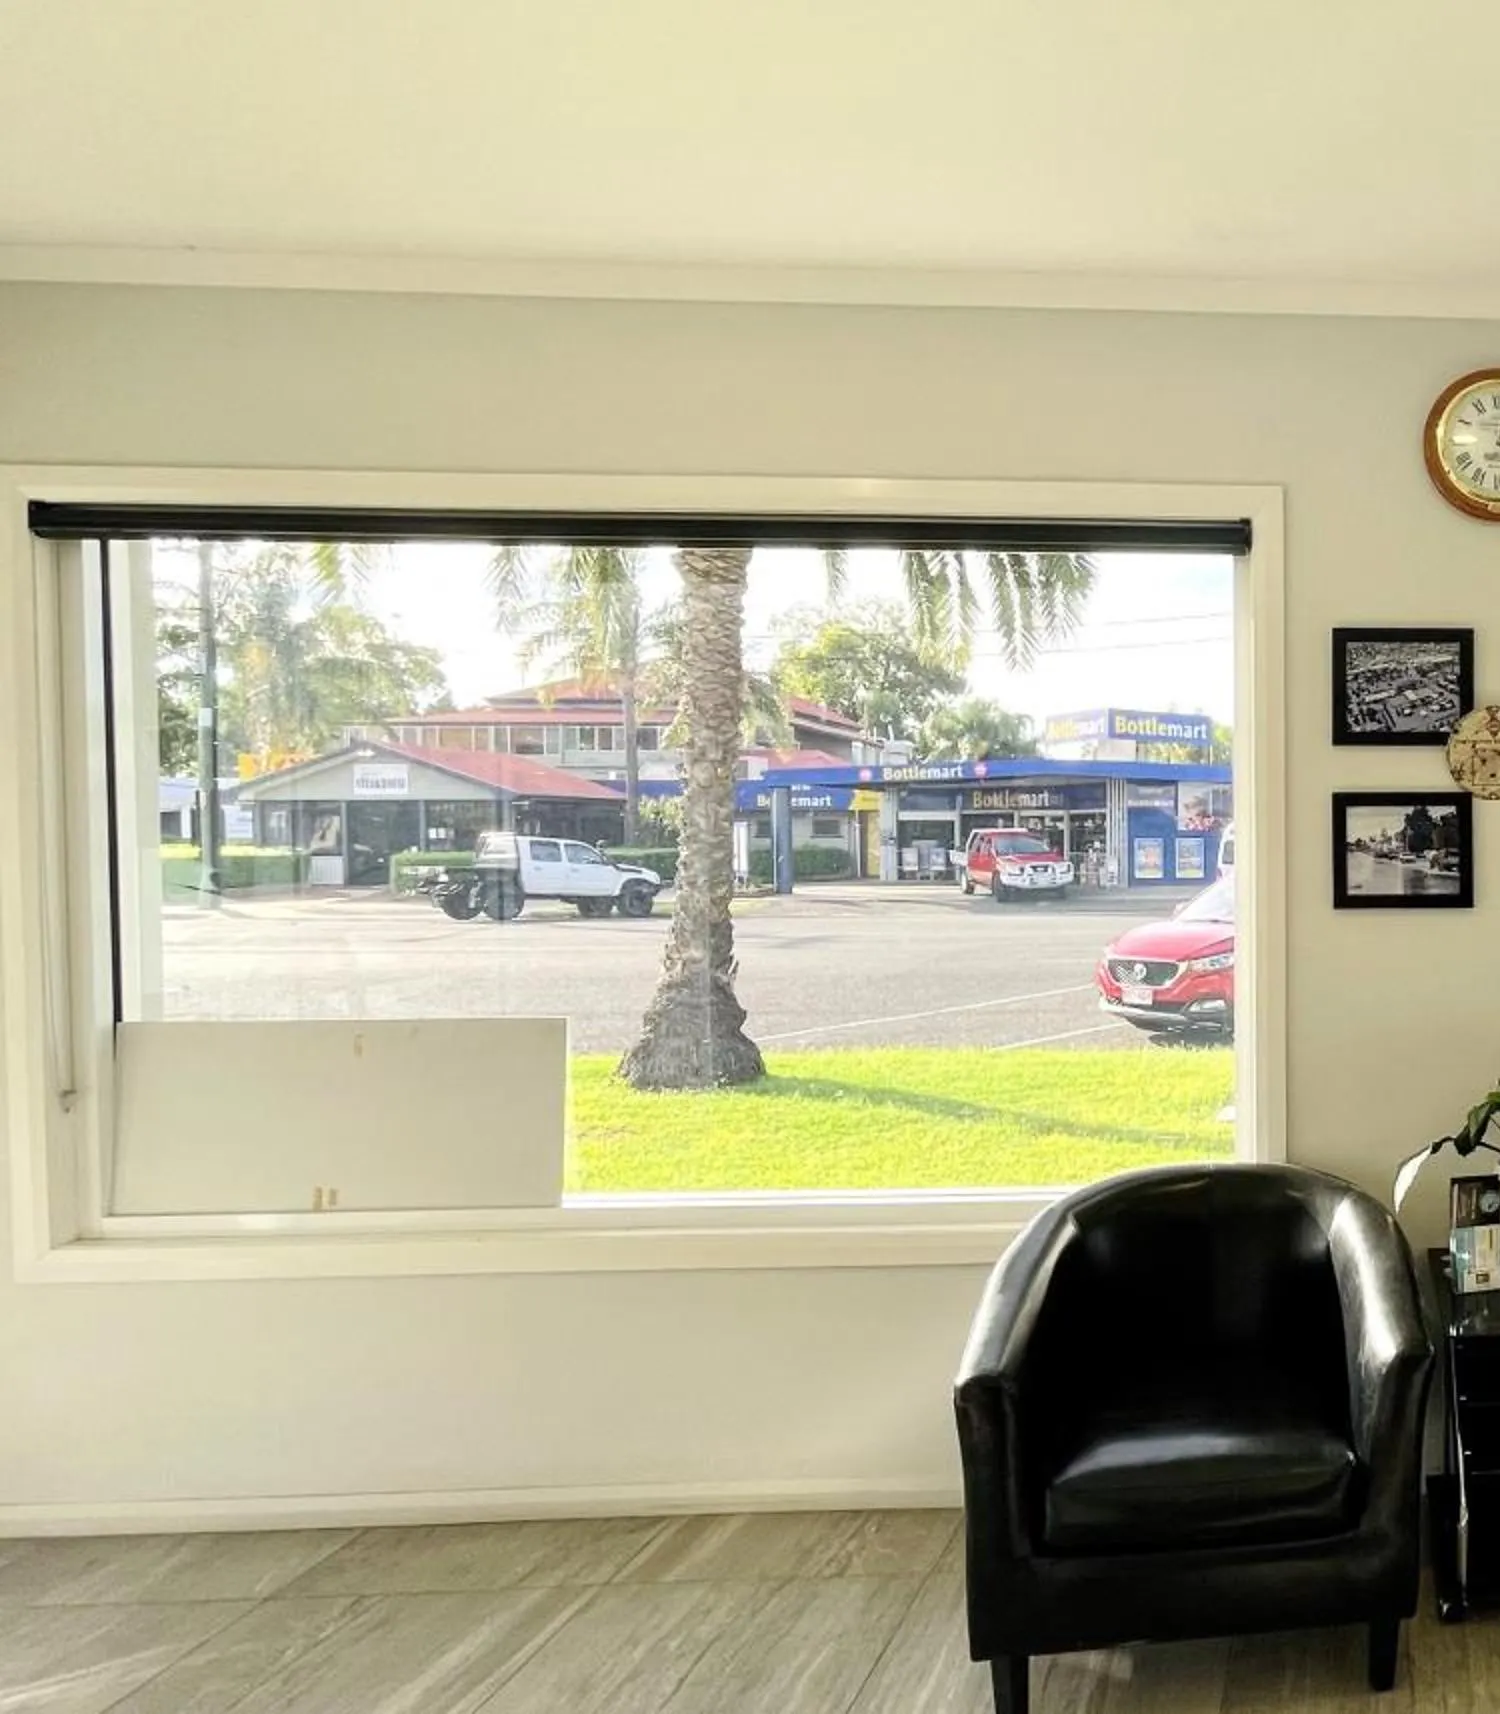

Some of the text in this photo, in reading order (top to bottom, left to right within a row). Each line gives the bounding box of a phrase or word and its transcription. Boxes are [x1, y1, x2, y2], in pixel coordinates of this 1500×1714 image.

[1115, 715, 1208, 739] Bottlemart
[883, 765, 963, 780] Bottlemart
[757, 793, 832, 807] Boemart
